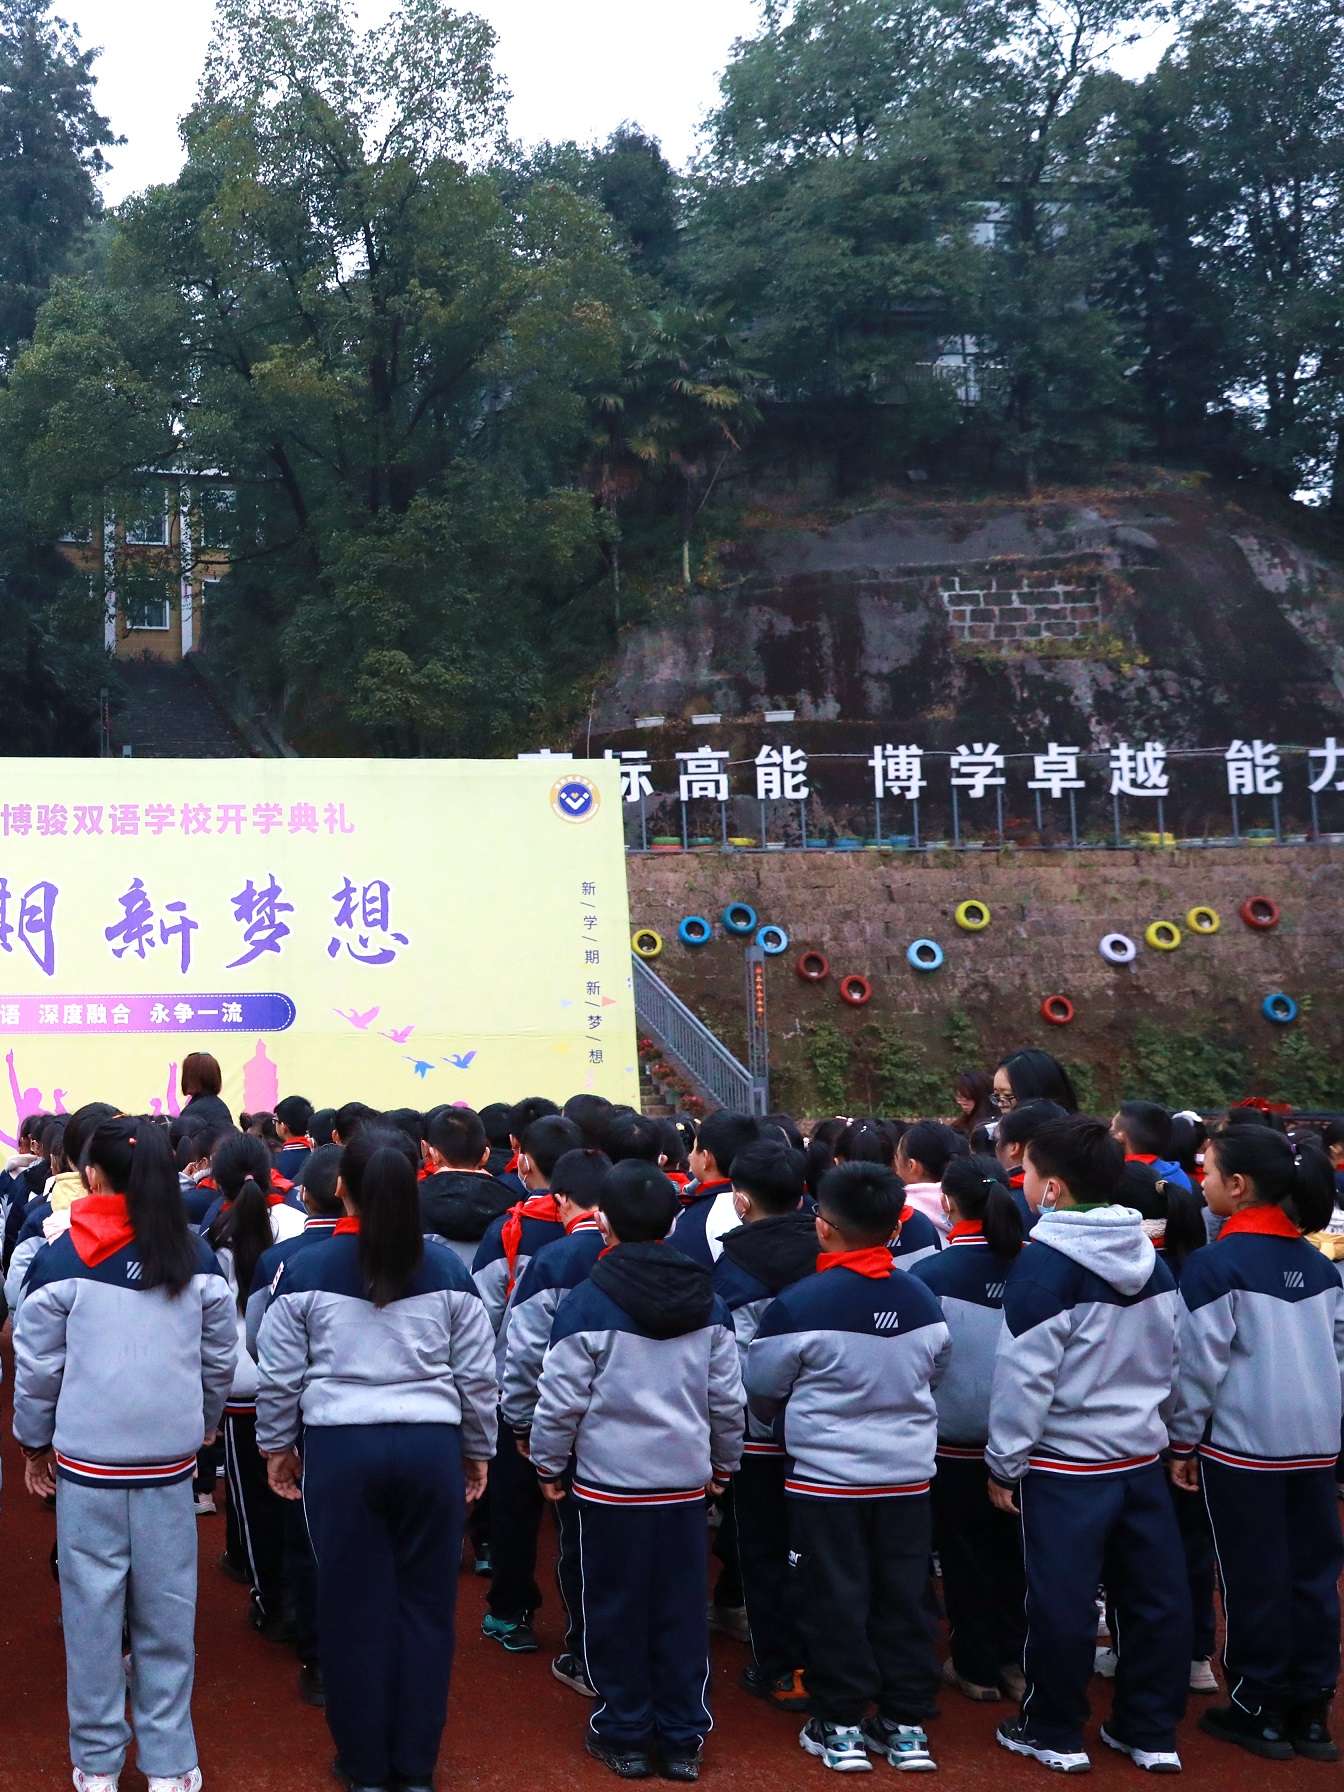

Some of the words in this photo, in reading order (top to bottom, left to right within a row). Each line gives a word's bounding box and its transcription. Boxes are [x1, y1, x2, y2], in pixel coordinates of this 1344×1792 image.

[518, 745, 810, 802] 标高能
[868, 742, 1169, 799] 博学卓越
[103, 872, 410, 975] 新梦想
[38, 1002, 132, 1026] 深度融合
[149, 1001, 244, 1024] 永争一流
